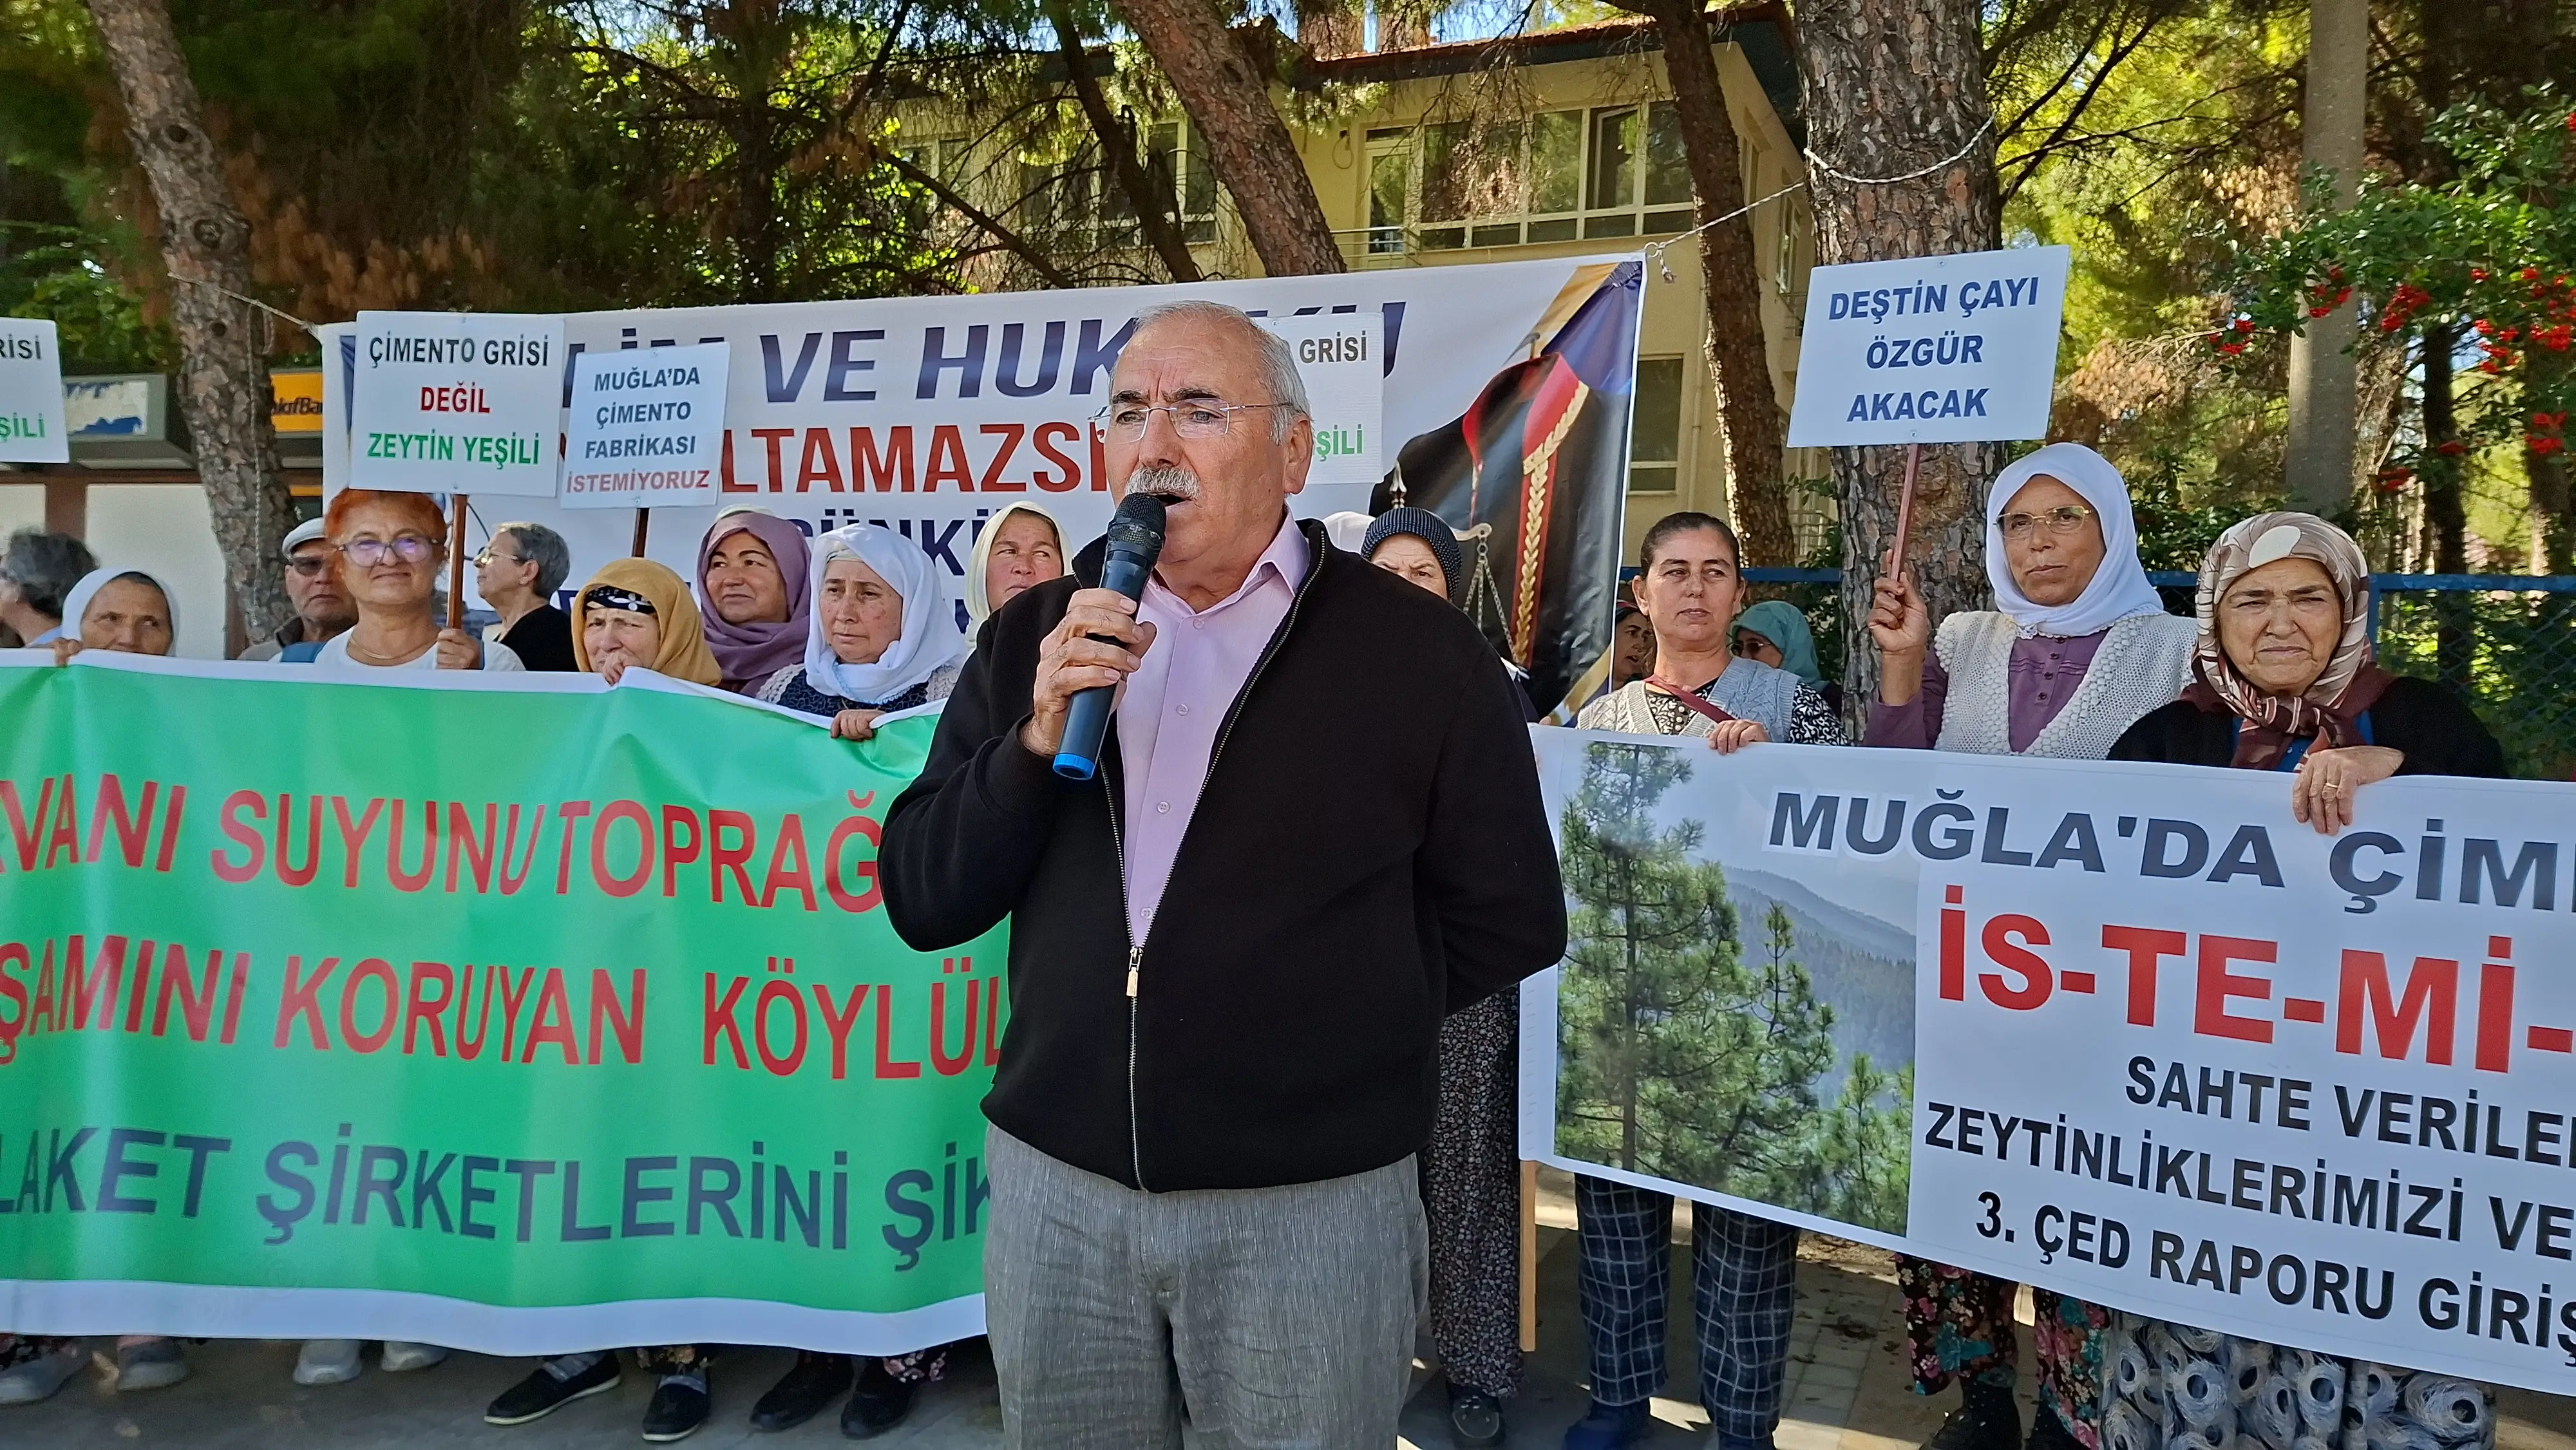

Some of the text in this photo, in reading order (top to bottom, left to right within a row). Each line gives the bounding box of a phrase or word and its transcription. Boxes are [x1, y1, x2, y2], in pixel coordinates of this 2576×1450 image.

[1829, 277, 2040, 324] DEŞTİN ÇAYI
[370, 331, 548, 368] ÇİMENTO GRİSİ
[760, 330, 885, 402] VE
[1300, 330, 1367, 363] GRİSİ
[1866, 331, 1984, 369] ÖZGÜR
[421, 381, 490, 413] DEĞİL
[596, 402, 692, 429] ÇİMENTO
[1846, 388, 1990, 422] AKACAK
[367, 429, 540, 470] ZEYTİN YEŞİLİ
[585, 433, 696, 459] FABRİKASI
[1313, 424, 1363, 462] ŞİLİ
[566, 468, 710, 493] İSTEMİYORUZ
[0, 773, 884, 913] VANI SUYUNU TOPRAĞ
[1768, 788, 2576, 913] MUĞLA'DA ÇİM
[0, 935, 251, 1066] ŞAMINI
[274, 956, 646, 1065] KORUYAN
[1939, 884, 2573, 1073] İS-TE-Mİ-
[2126, 1056, 2576, 1169] SAHTE VERİLE
[0, 1127, 232, 1218] AKET
[256, 1122, 848, 1250] ŞİRKETLERİNİ
[1926, 1102, 2575, 1261] ZEYTİNLİKLERİMİZİ VE
[1975, 1191, 2015, 1243] 3.
[2034, 1204, 2130, 1269] ÇED
[2150, 1229, 2394, 1319] RAPORU
